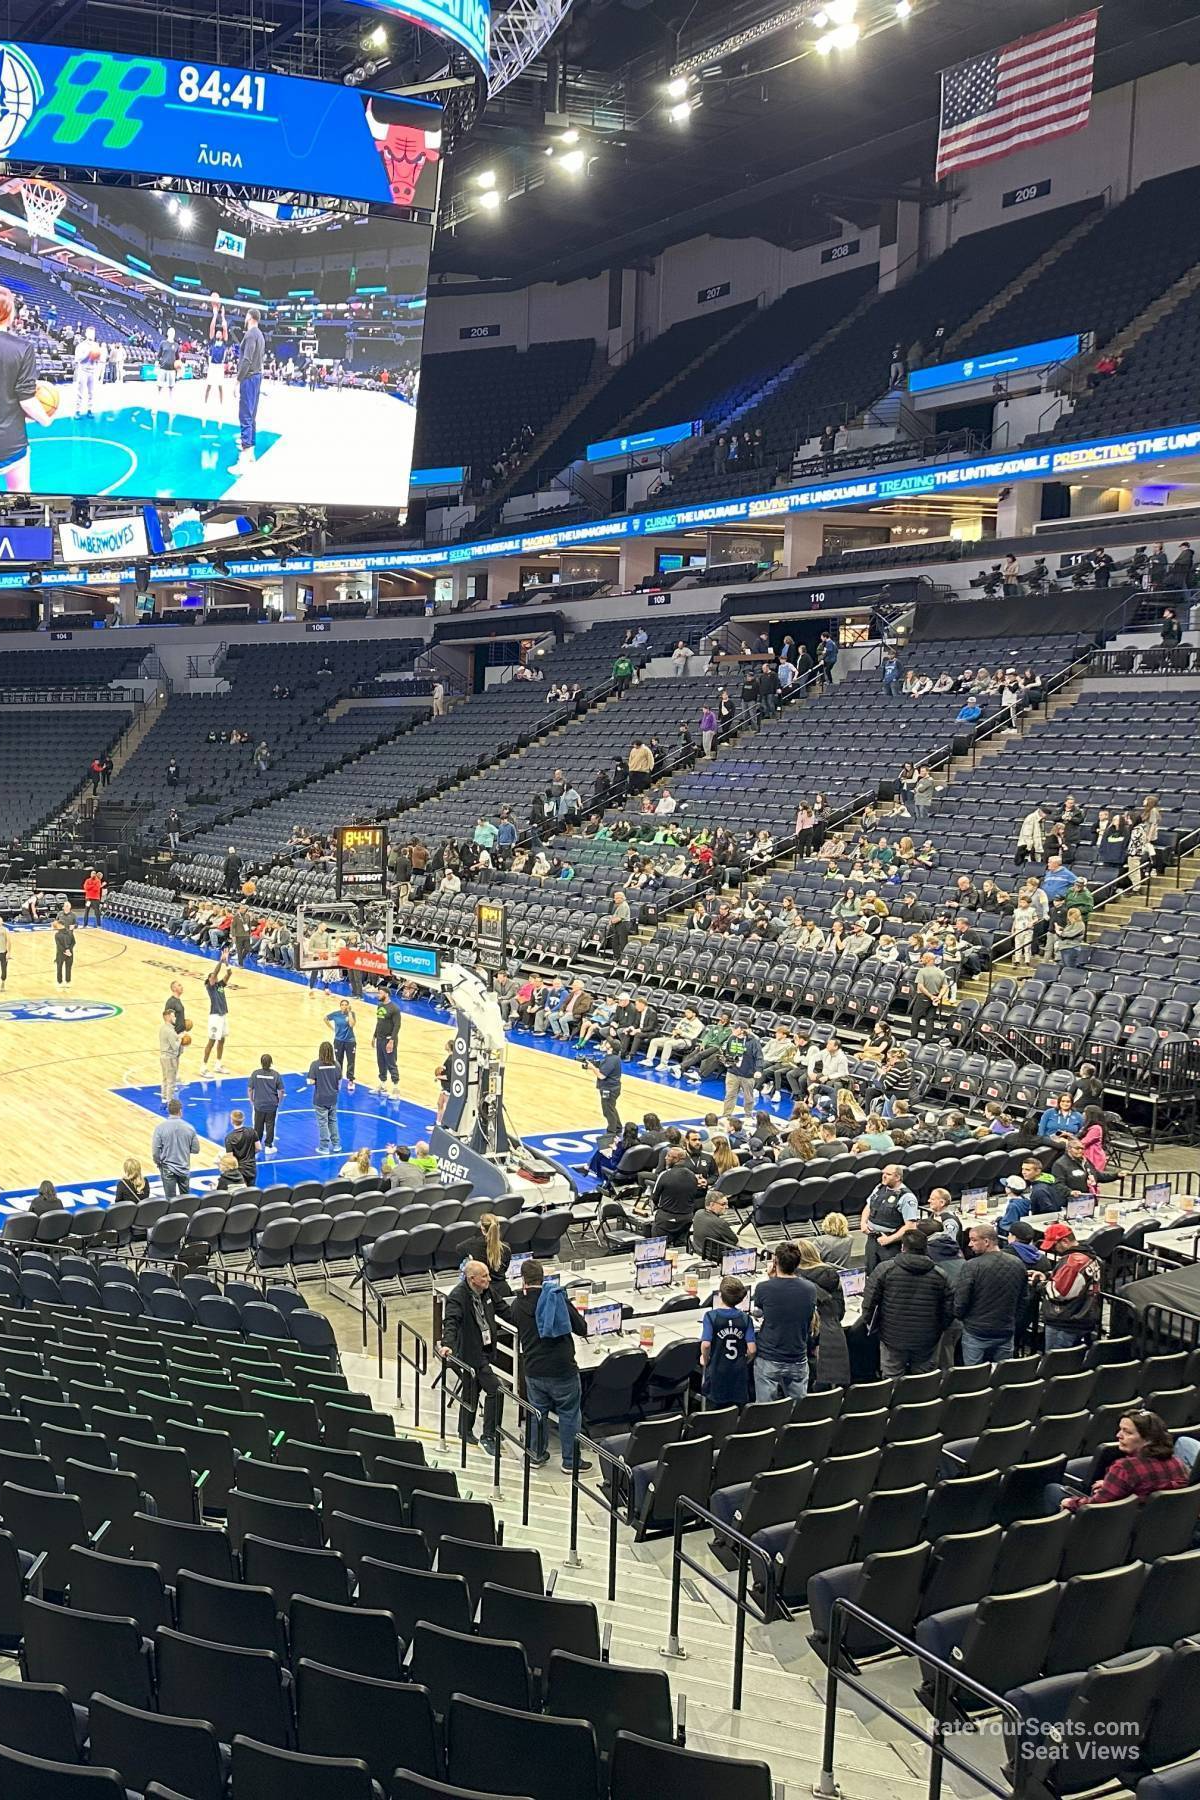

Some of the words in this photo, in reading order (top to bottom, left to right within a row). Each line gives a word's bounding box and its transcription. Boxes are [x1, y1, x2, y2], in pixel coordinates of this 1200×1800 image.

[178, 66, 266, 111] 84:41
[1014, 185, 1038, 203] 209
[831, 244, 849, 259] 208
[706, 286, 721, 300] 207
[470, 327, 489, 337] 206
[1053, 441, 1137, 465] PREDICTING
[1136, 437, 1167, 454] THE
[879, 474, 934, 493] TREATING
[934, 470, 958, 485] THE
[959, 454, 1050, 481] UNTREATABLE
[749, 497, 791, 510] SOLVING
[789, 493, 811, 508] THE
[644, 514, 677, 528] CURING
[676, 512, 694, 524] THE
[70, 524, 135, 553] TIMBERWOLVES
[313, 559, 366, 571] PREDICTING
[653, 596, 666, 604] 109
[810, 592, 825, 603] 110
[345, 831, 380, 846] 84:41
[355, 873, 383, 882] TISSOT
[402, 956, 431, 966] CFMOTO
[725, 1339, 738, 1360] 5
